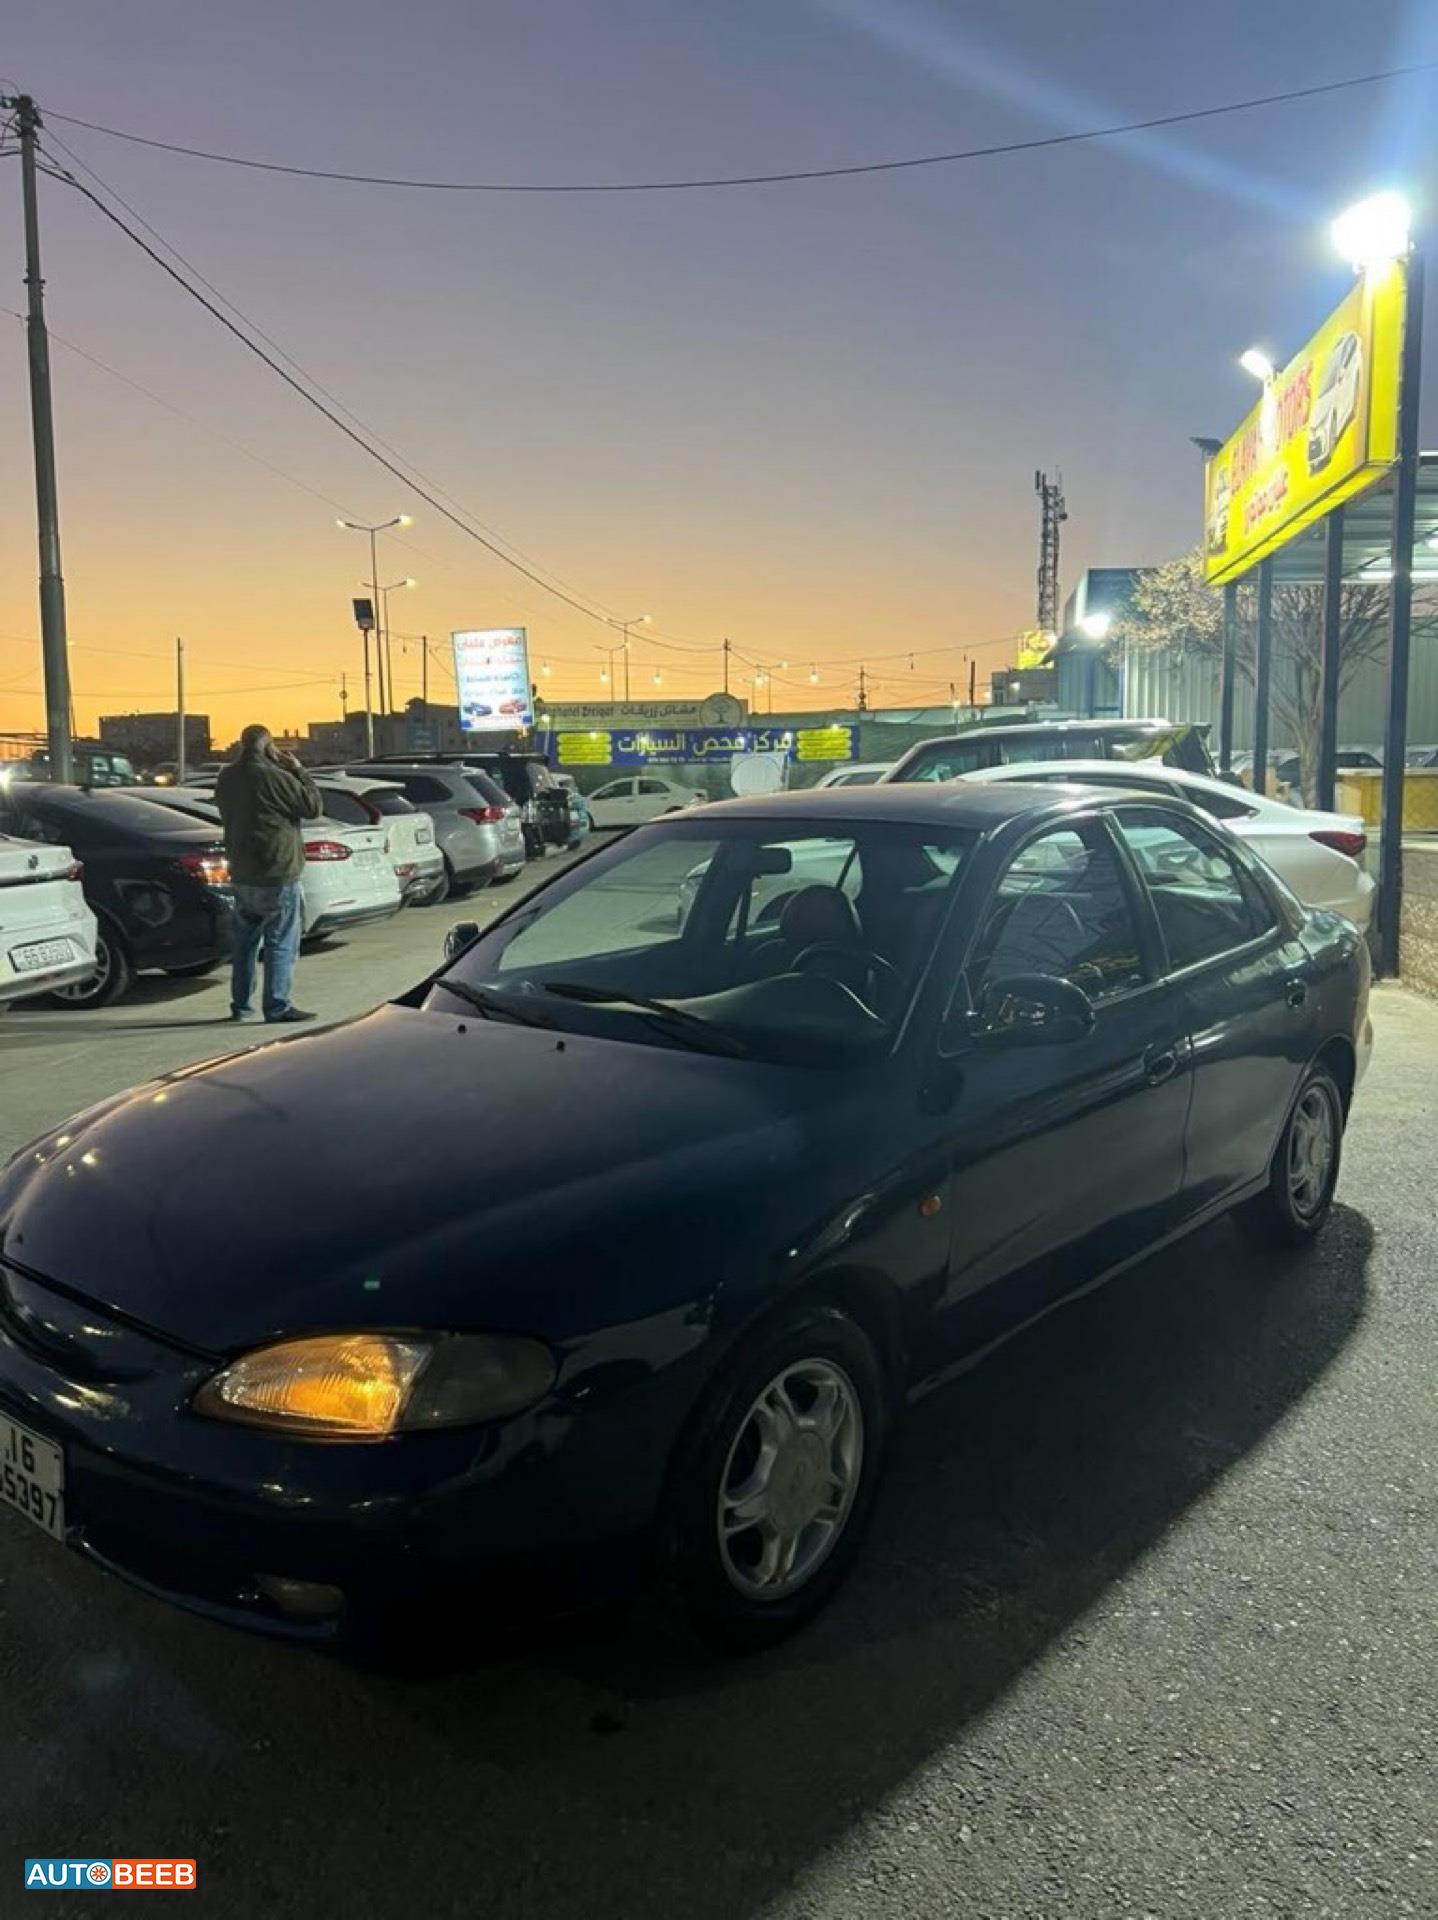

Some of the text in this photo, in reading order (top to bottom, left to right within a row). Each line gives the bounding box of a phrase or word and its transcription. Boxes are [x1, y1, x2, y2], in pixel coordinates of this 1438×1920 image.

[617, 731, 686, 757] السيارات
[692, 732, 746, 756] فحص
[752, 730, 793, 753] مركز
